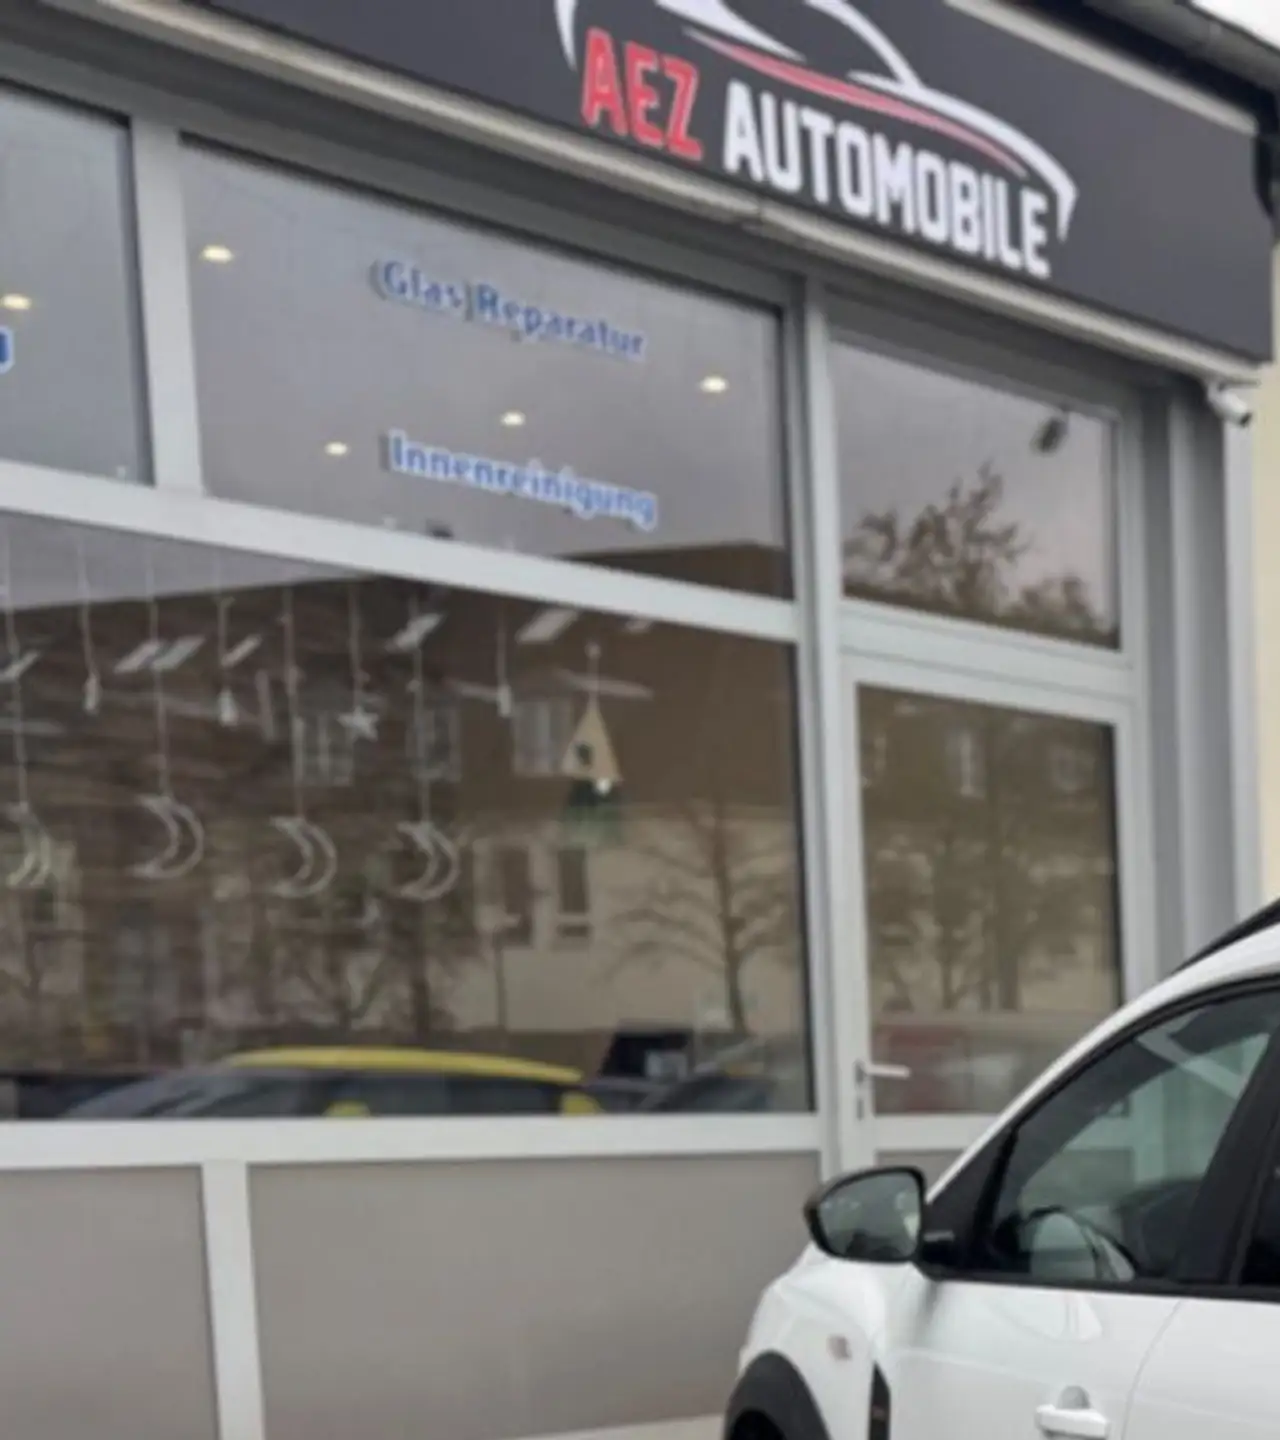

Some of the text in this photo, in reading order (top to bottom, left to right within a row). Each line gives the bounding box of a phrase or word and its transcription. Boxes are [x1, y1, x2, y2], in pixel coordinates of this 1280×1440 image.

[582, 27, 1050, 278] AEZ AUTOMOBILE
[382, 259, 646, 359] Glas Reparatur
[389, 430, 657, 530] Innenreinigung
